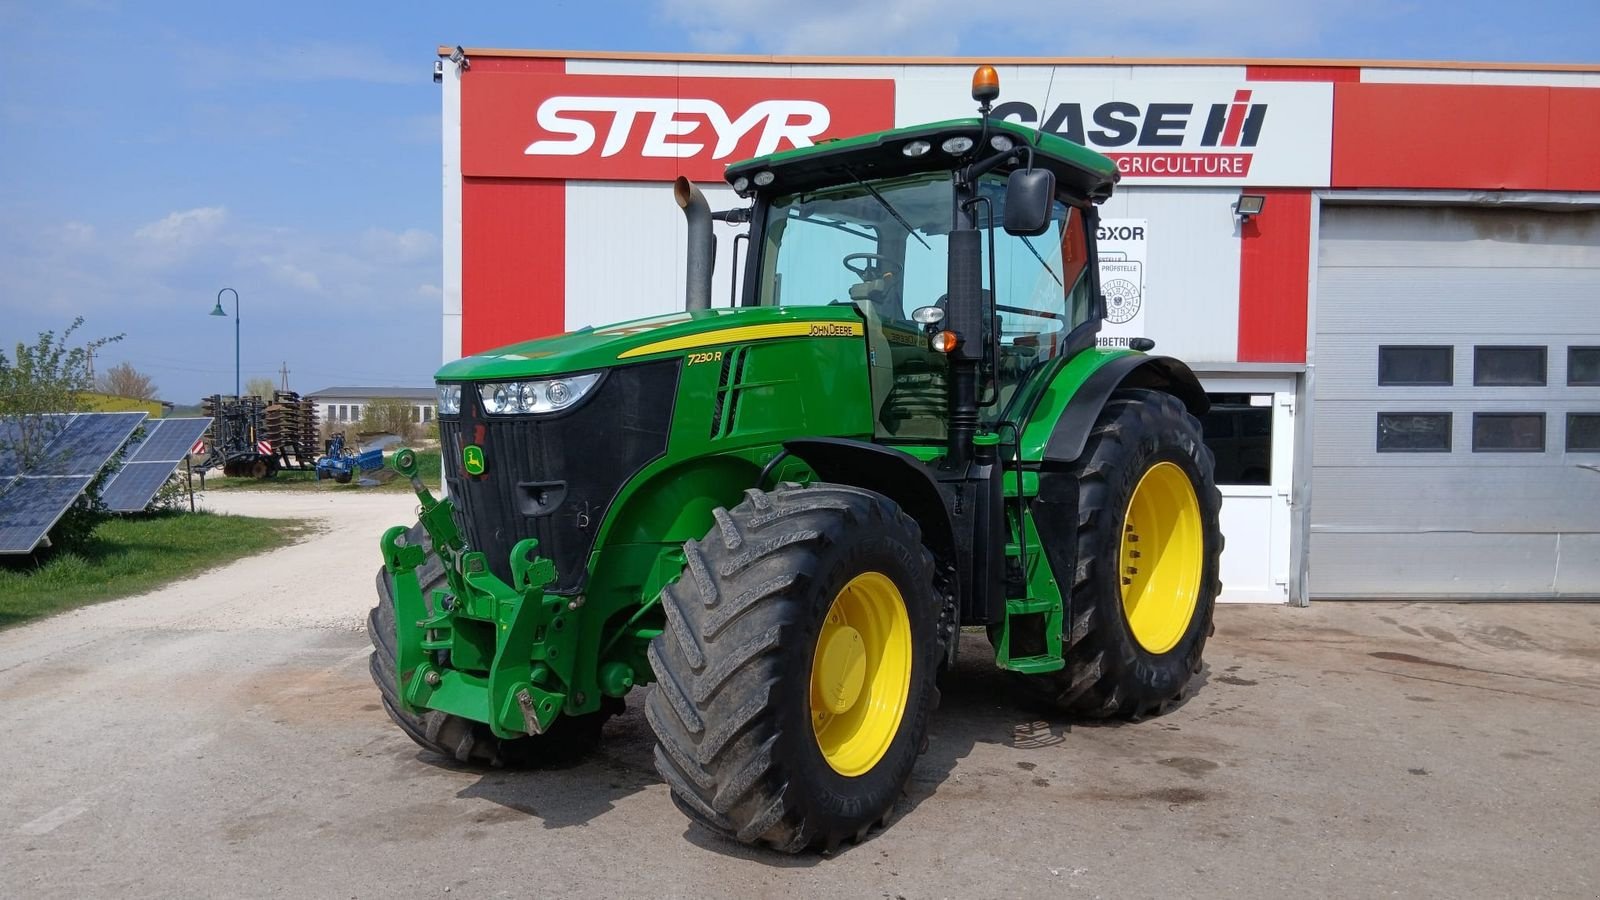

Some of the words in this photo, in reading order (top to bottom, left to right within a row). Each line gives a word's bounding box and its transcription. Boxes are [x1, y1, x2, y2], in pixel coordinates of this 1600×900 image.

[524, 96, 830, 160] STEYR
[1116, 156, 1243, 173] GRICULTURE
[1096, 226, 1145, 241] GXOR
[1101, 264, 1137, 272] PRÜFSTELLE
[808, 323, 829, 336] JOHN
[829, 323, 853, 336] DEERE
[1096, 337, 1134, 347] HBETRI
[687, 352, 714, 367] 7230
[714, 351, 722, 361] R
